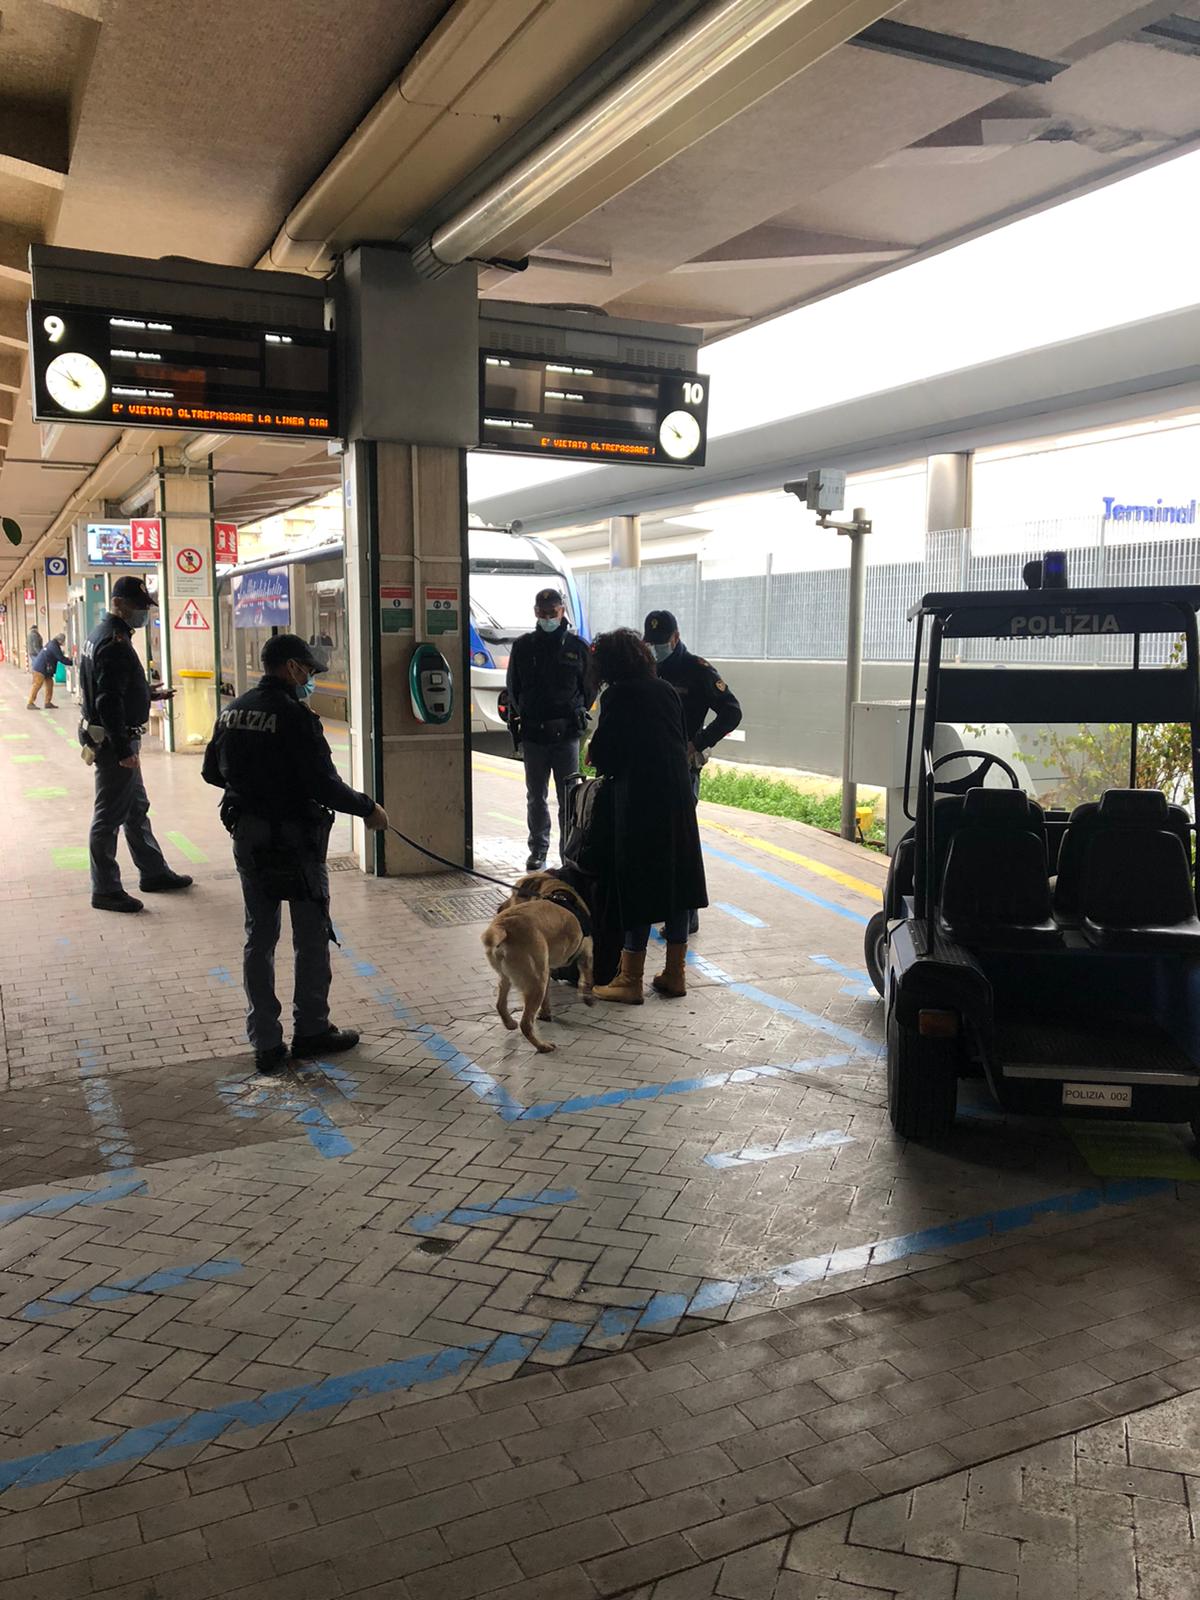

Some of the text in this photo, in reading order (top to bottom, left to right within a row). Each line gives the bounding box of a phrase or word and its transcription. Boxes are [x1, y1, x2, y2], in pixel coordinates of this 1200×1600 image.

[44, 315, 65, 342] 9
[682, 382, 704, 404] 10
[128, 404, 173, 417] VIETATO
[177, 408, 254, 423] OLTREPASSARE
[258, 414, 271, 424] LA
[275, 415, 305, 427] LINEA
[553, 439, 588, 449] VIETATO
[591, 442, 649, 454] OLTREPASSARE
[1103, 496, 1196, 524] Terminal
[1010, 613, 1120, 635] POLIZIA
[219, 709, 277, 733] POLIZIA
[1065, 1089, 1128, 1101] POLIZIA 002
